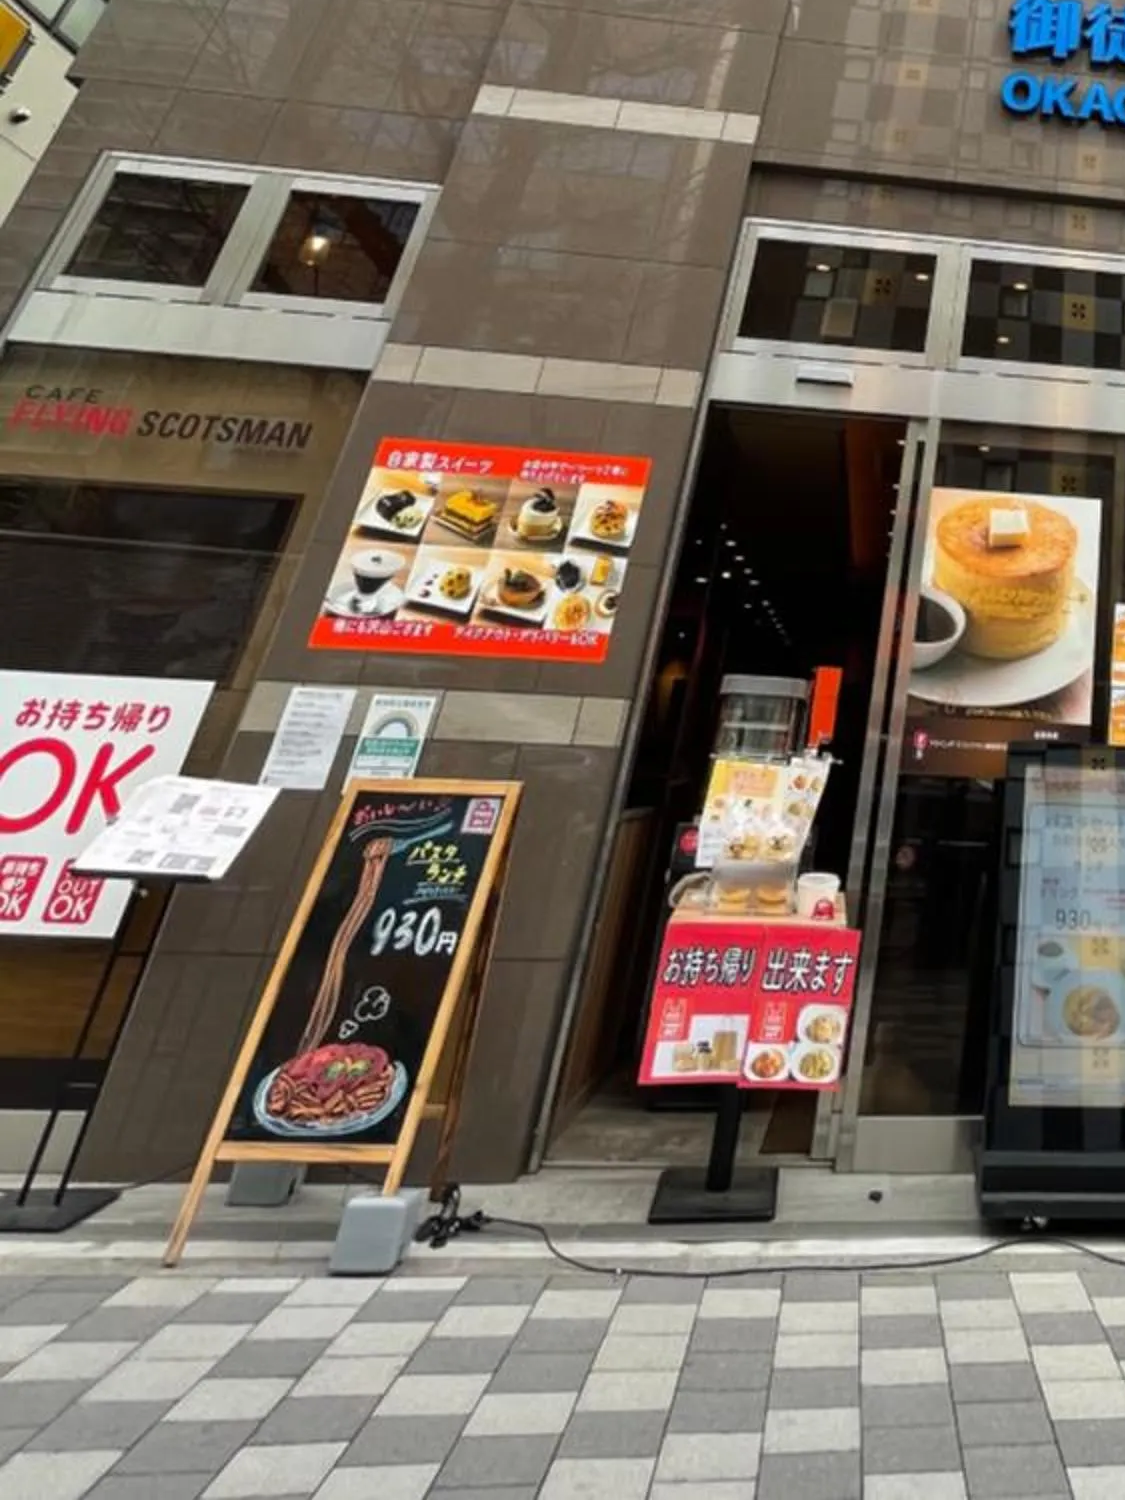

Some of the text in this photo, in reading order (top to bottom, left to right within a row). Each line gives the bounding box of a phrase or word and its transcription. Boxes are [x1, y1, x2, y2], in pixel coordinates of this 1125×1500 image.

[25, 384, 105, 405] CAFE
[136, 410, 314, 450] SCOTSMAN
[15, 698, 173, 734] お持ち帰り
[0, 736, 156, 836] OK
[57, 878, 99, 897] OUT
[48, 894, 93, 920] OK
[370, 906, 459, 957] 930円
[663, 946, 854, 995] お持ち帰り 出来ます
